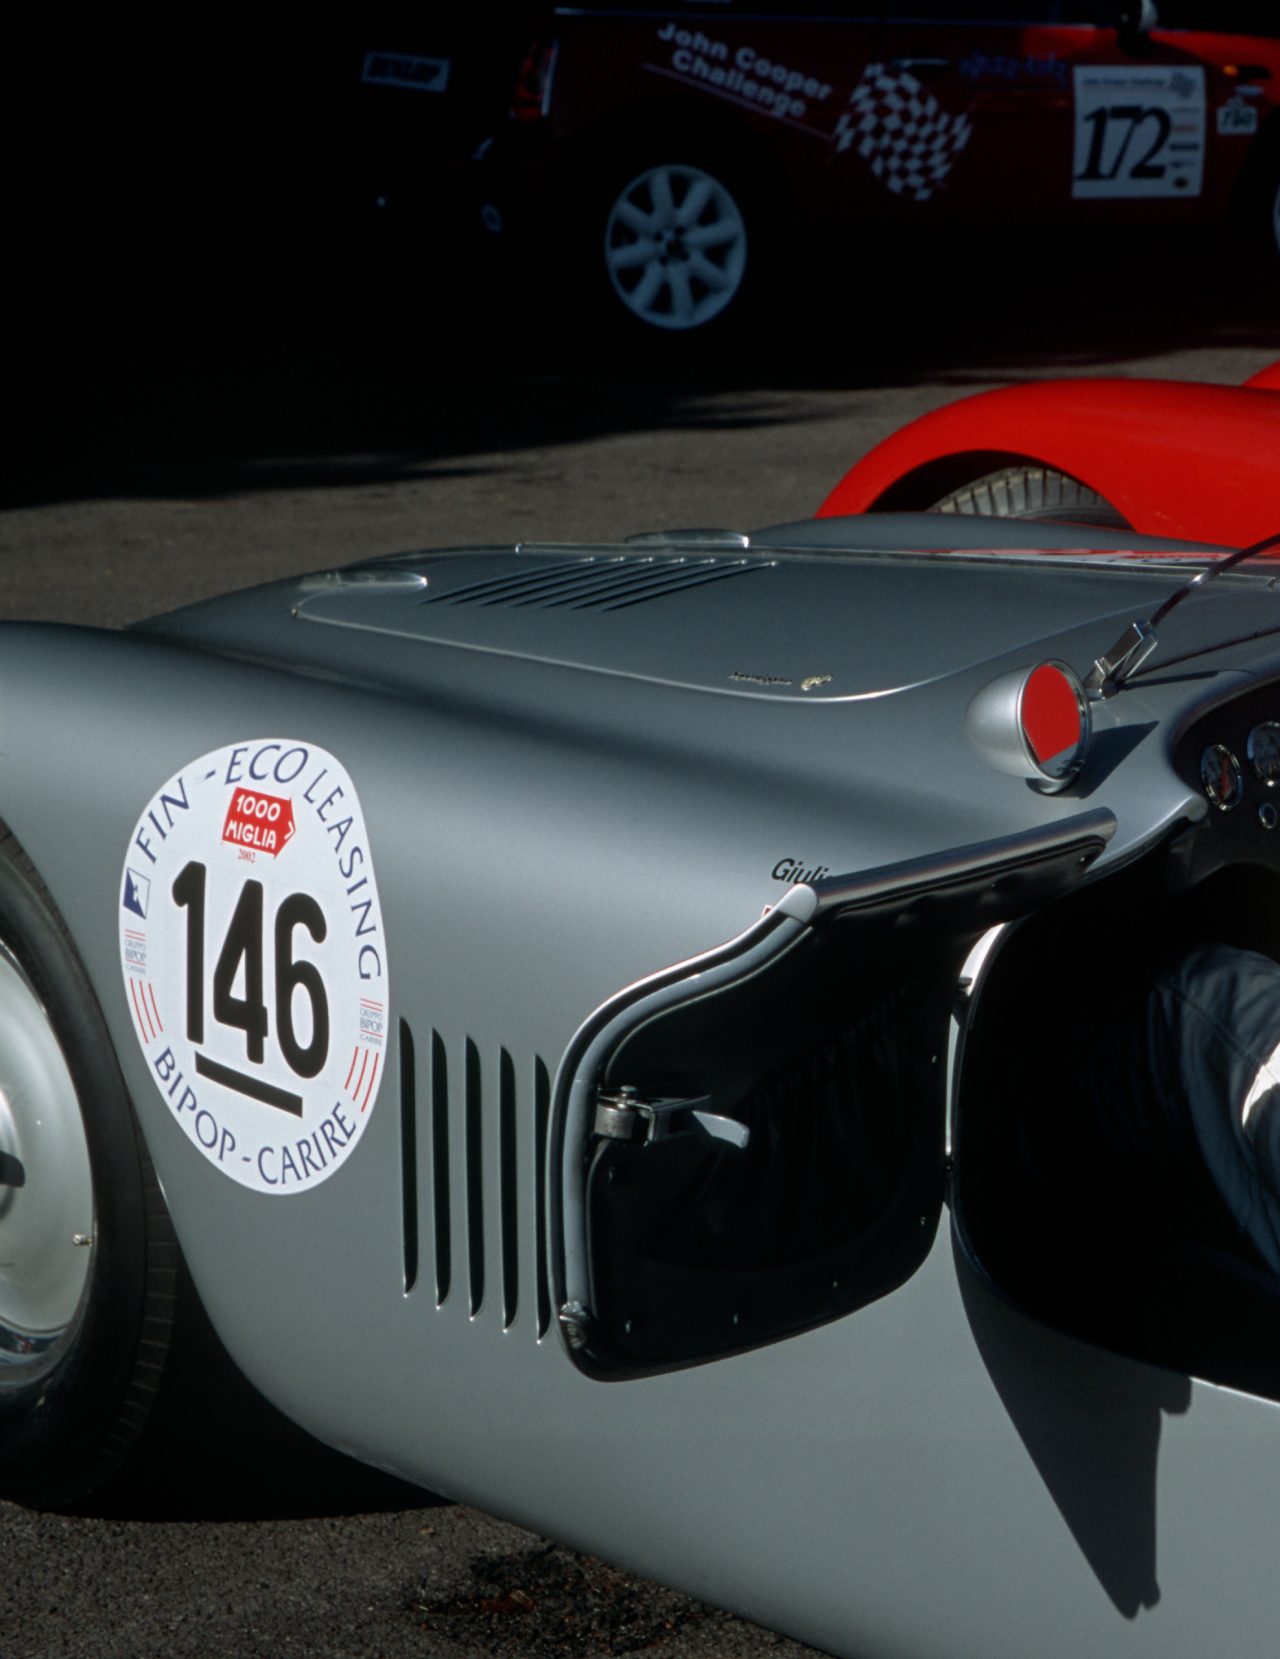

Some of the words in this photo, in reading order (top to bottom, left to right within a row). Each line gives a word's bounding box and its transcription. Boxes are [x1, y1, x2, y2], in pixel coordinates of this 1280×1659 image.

[656, 21, 729, 61] John
[734, 46, 833, 101] Cooper
[672, 48, 807, 117] Challenge
[1076, 106, 1171, 179] 172
[225, 820, 277, 850] MIGLIA
[236, 794, 282, 822] 1000
[237, 849, 256, 864] 2002
[303, 769, 382, 980] LEASING
[171, 860, 330, 1080] 146
[359, 1017, 384, 1033] BIPOP
